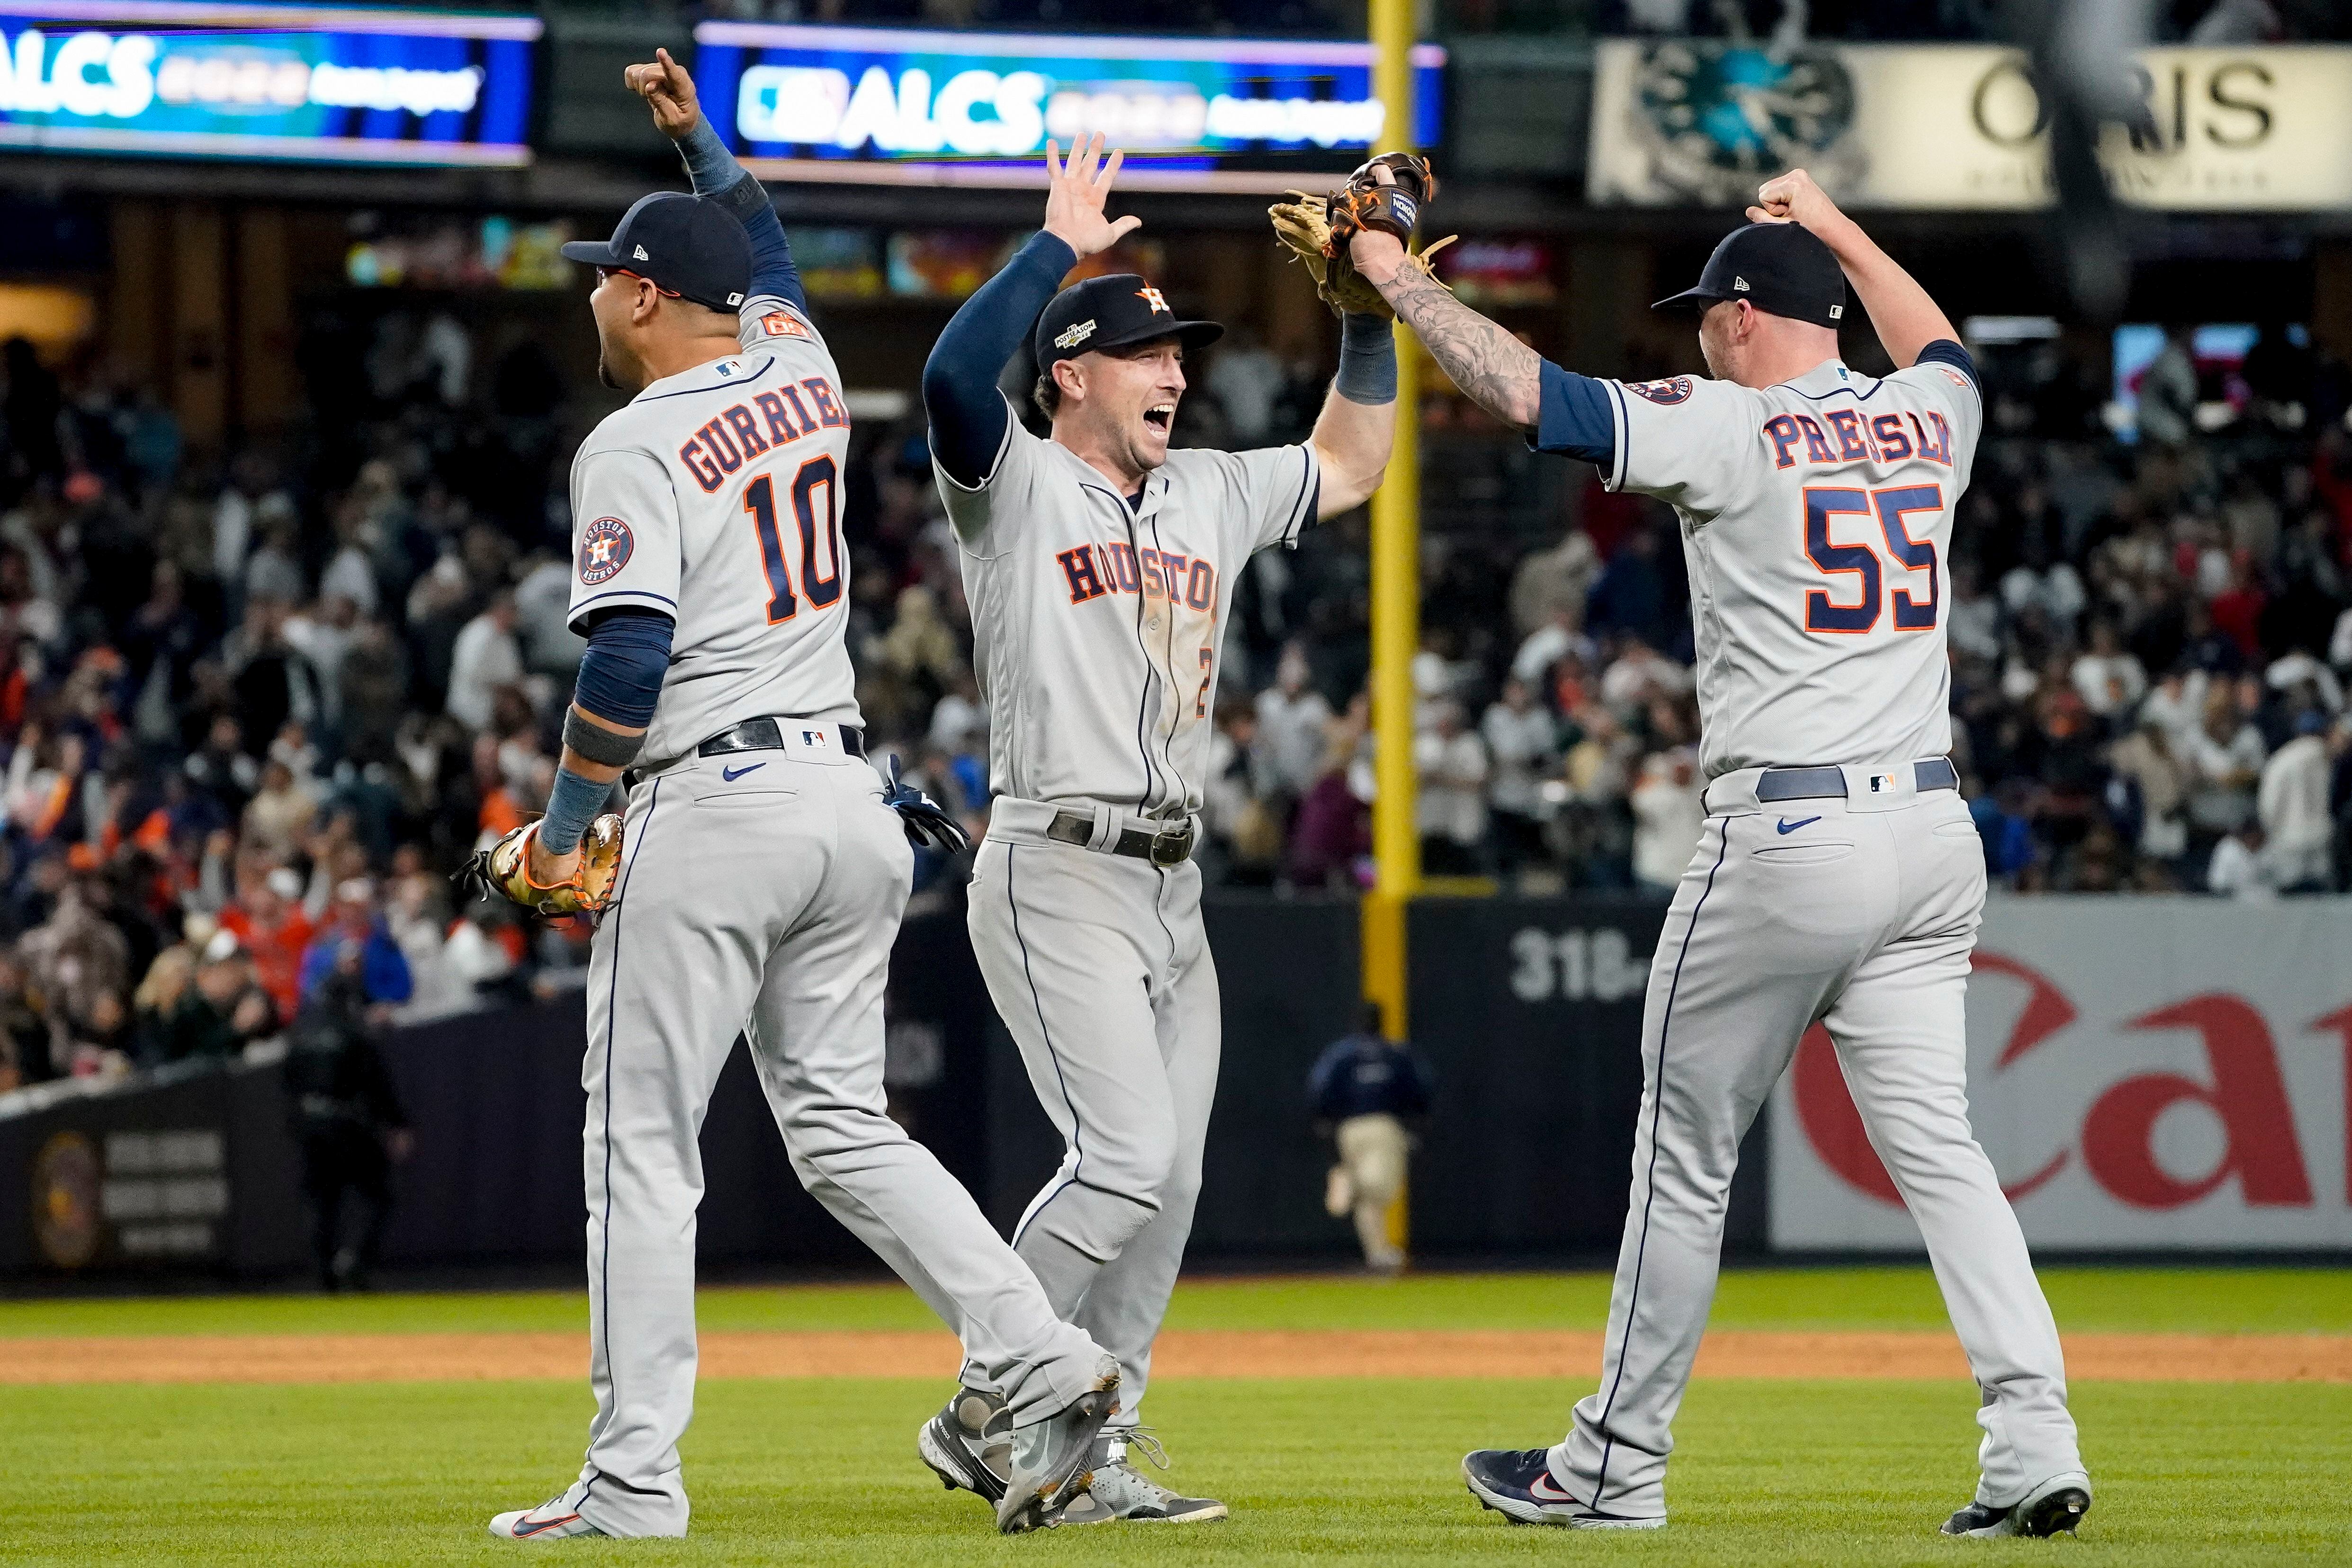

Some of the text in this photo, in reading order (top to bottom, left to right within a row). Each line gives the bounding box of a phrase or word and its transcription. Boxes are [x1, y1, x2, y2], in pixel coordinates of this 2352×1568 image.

[0, 29, 155, 117] LCS
[836, 65, 1047, 154] ALCS
[1056, 322, 1094, 345] POSTSEASON
[583, 561, 620, 580] ASTROS
[584, 521, 626, 546] HOUSTON
[590, 538, 612, 565] H
[743, 453, 842, 626] 10
[1803, 483, 1944, 634] 55
[1056, 542, 1220, 623] HUSTO
[1513, 927, 1628, 1002] 318
[1793, 949, 2352, 1210] Ca
